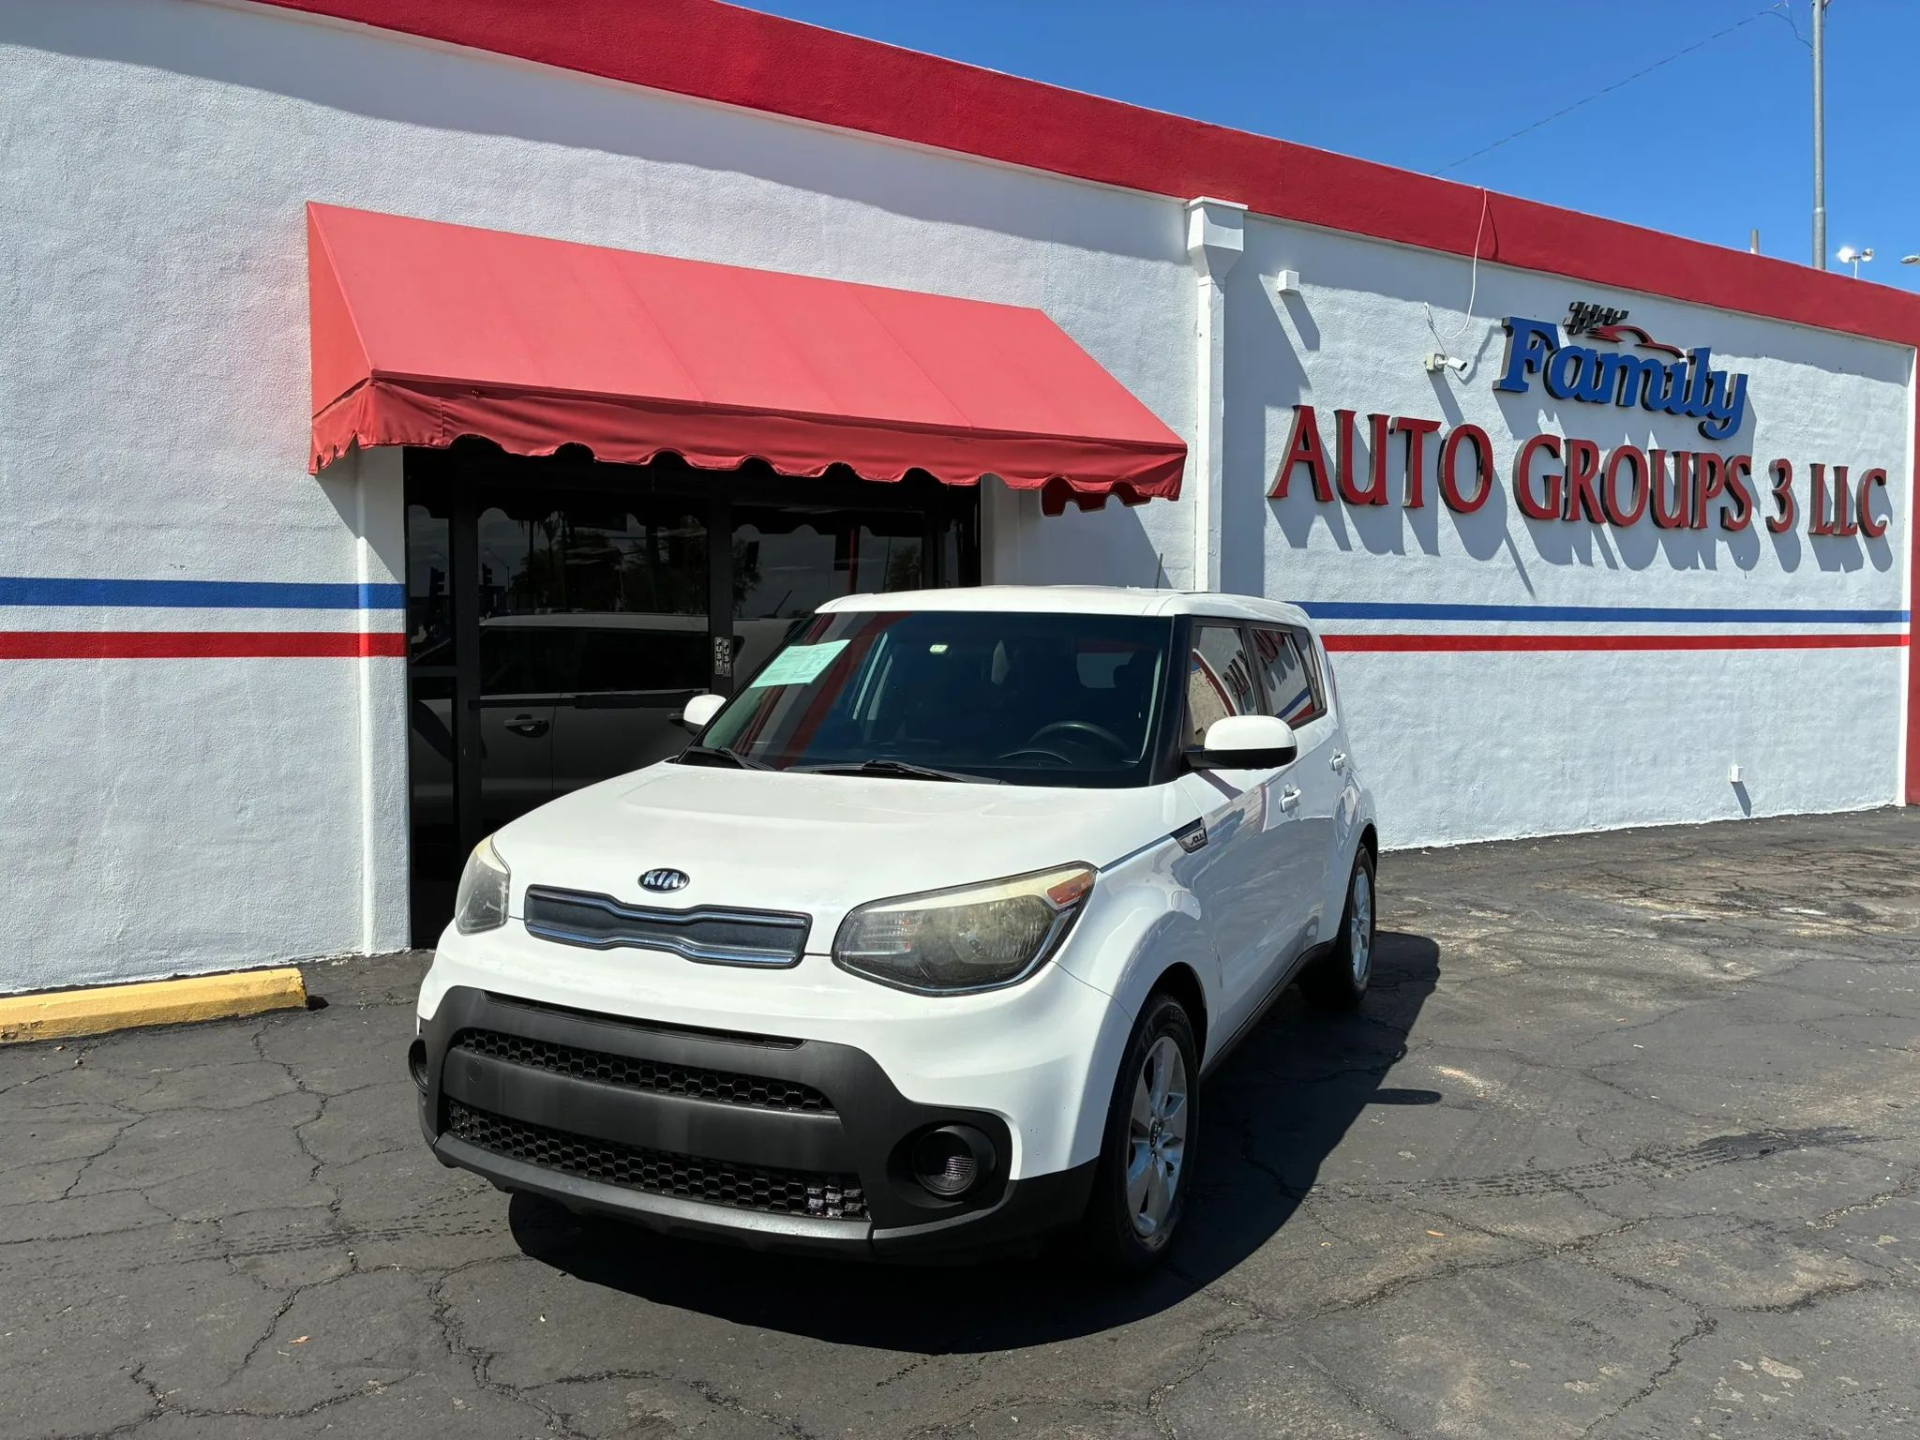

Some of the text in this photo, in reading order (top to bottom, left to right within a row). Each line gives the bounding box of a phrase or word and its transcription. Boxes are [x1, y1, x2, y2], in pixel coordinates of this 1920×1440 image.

[1492, 316, 1748, 440] Family
[1266, 405, 1888, 538] AUTO GROUPS 3 LLC
[643, 870, 681, 889] KIA
